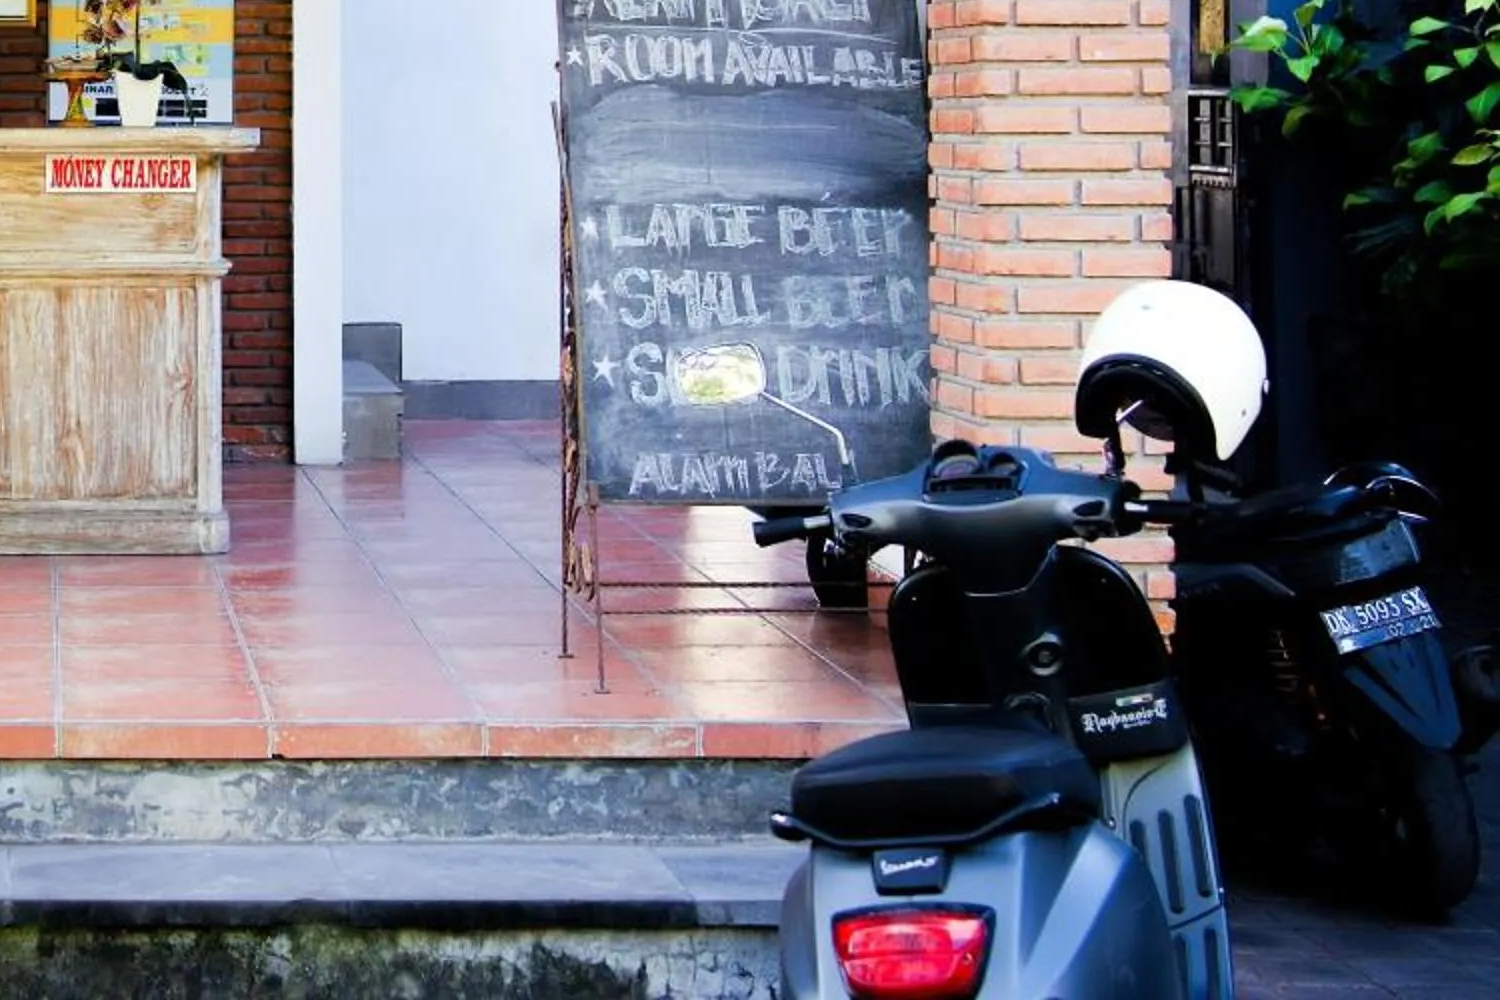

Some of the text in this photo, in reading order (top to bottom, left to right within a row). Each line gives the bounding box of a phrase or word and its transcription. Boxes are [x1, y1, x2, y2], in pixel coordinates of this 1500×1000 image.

[584, 34, 923, 88] ROOM AVAILABLE
[51, 158, 191, 187] MONEY CHANGER
[613, 266, 771, 330] SMALL
[1324, 605, 1352, 633] DK
[1355, 597, 1400, 625] 5093
